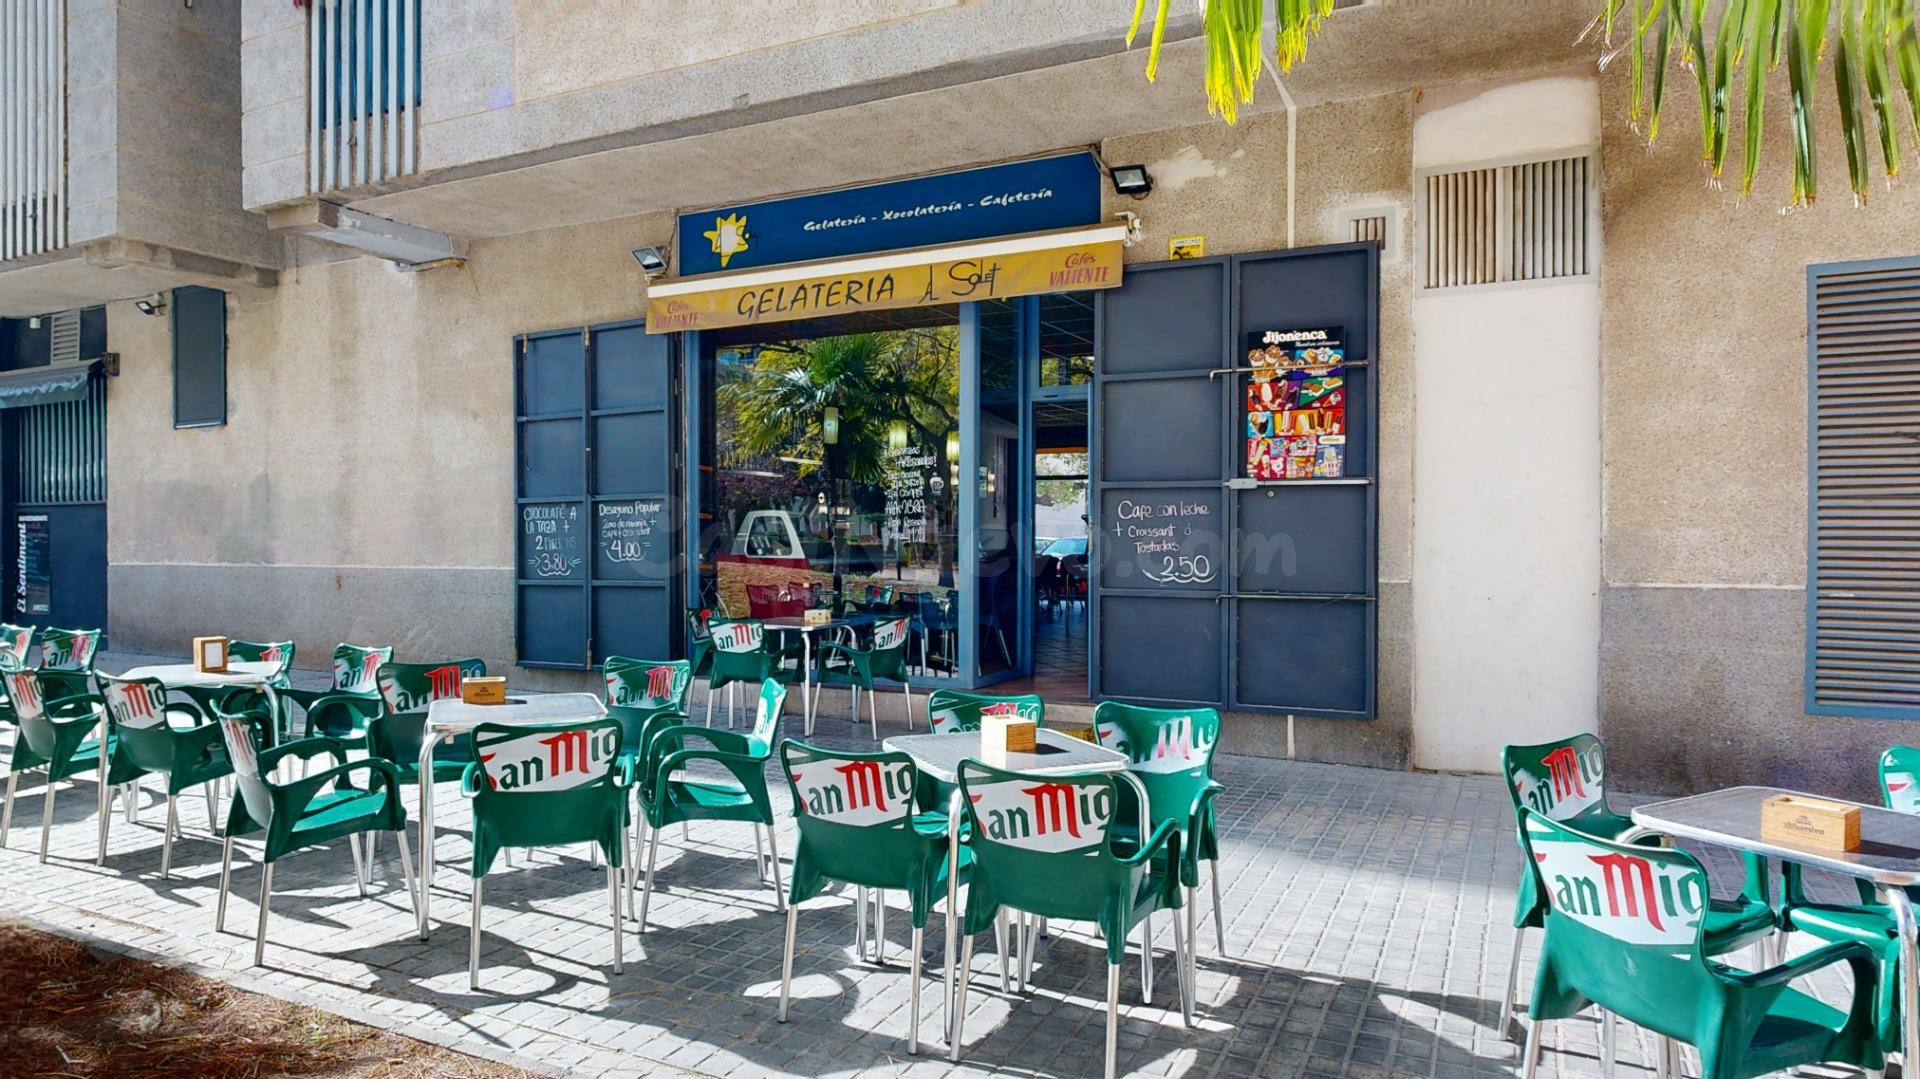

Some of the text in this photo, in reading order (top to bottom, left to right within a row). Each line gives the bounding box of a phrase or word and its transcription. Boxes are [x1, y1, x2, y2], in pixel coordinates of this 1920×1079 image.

[803, 214, 866, 231] Gelatería
[980, 188, 1052, 208] Cafetería
[1050, 266, 1110, 287] VALIENTE
[737, 274, 894, 320] GELATERIA
[570, 506, 577, 520] A
[599, 501, 661, 518] Desayuno Popular
[1157, 505, 1177, 516] con
[1180, 501, 1210, 516] leche
[1128, 523, 1176, 538] Croissant
[535, 535, 543, 550] 2
[611, 540, 641, 559] 4.00
[1134, 540, 1180, 555] Tostadas
[1160, 555, 1210, 577] 2.50
